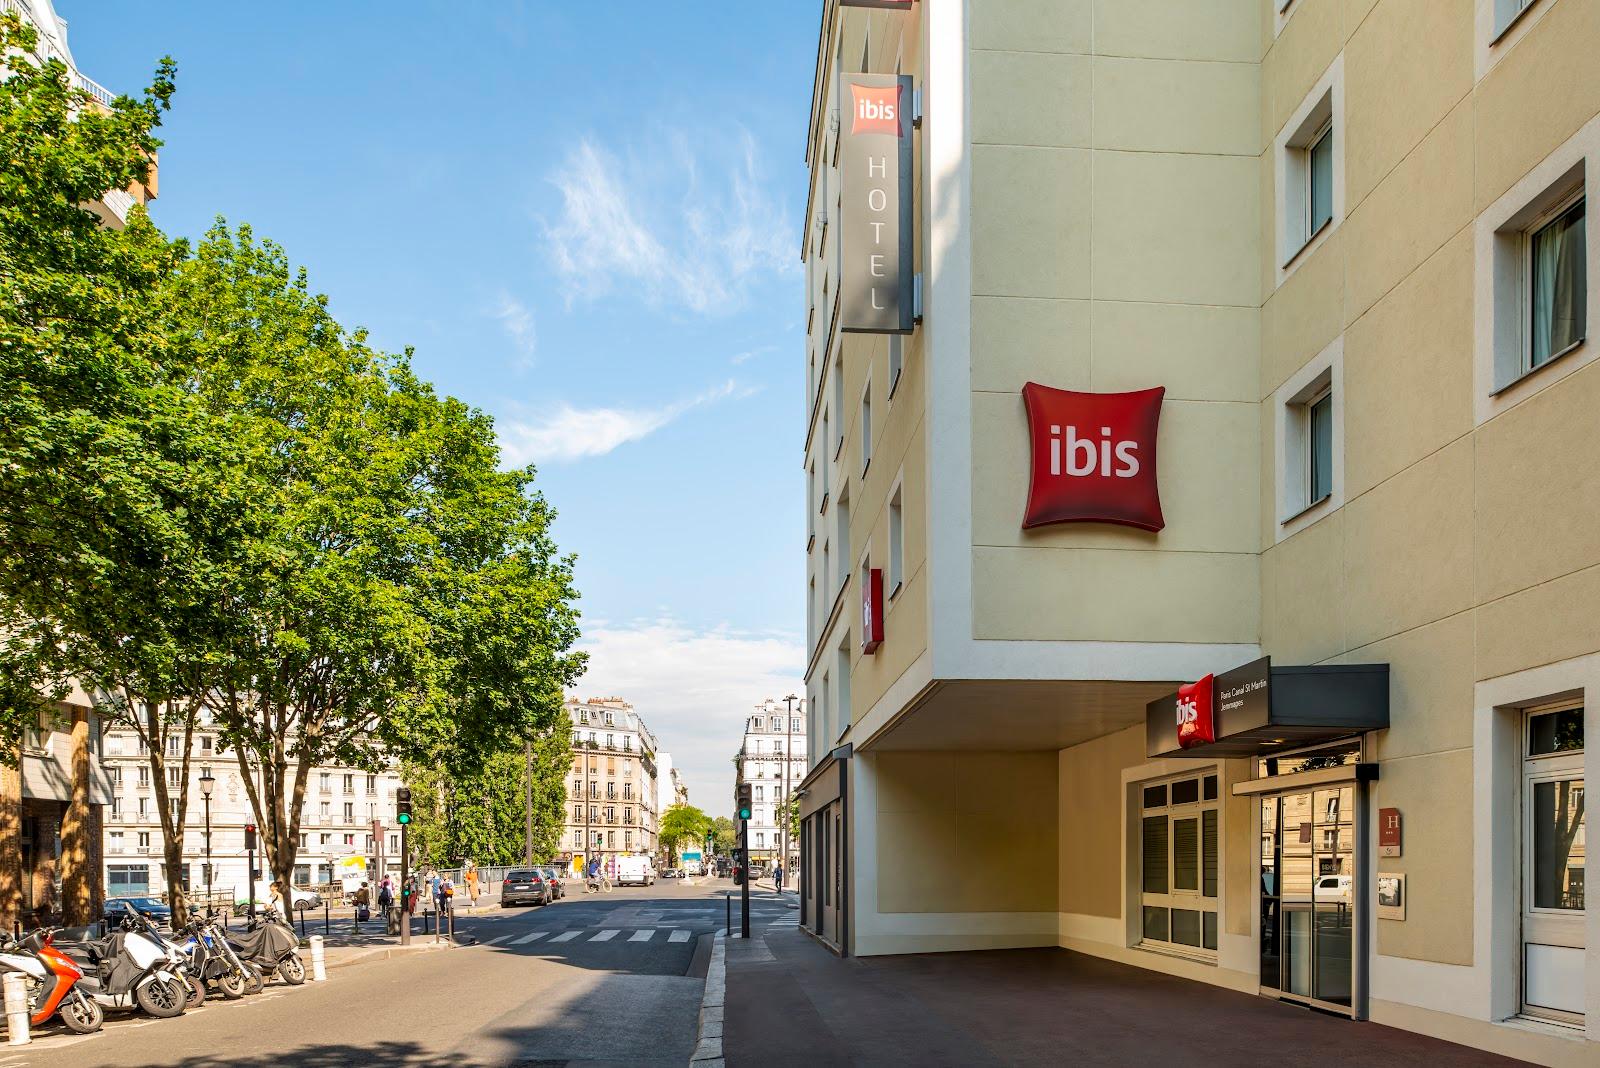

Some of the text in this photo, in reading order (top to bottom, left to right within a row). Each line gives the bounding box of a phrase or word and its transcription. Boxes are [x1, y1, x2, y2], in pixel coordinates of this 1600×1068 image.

[860, 99, 895, 120] ibis
[868, 156, 887, 310] HOTEL
[1050, 424, 1140, 478] ibis
[1220, 690, 1231, 700] Paris
[1232, 684, 1245, 697] Canal
[1251, 678, 1267, 690] Martin
[1220, 700, 1244, 711] Jemmapes
[1388, 815, 1399, 828] H
